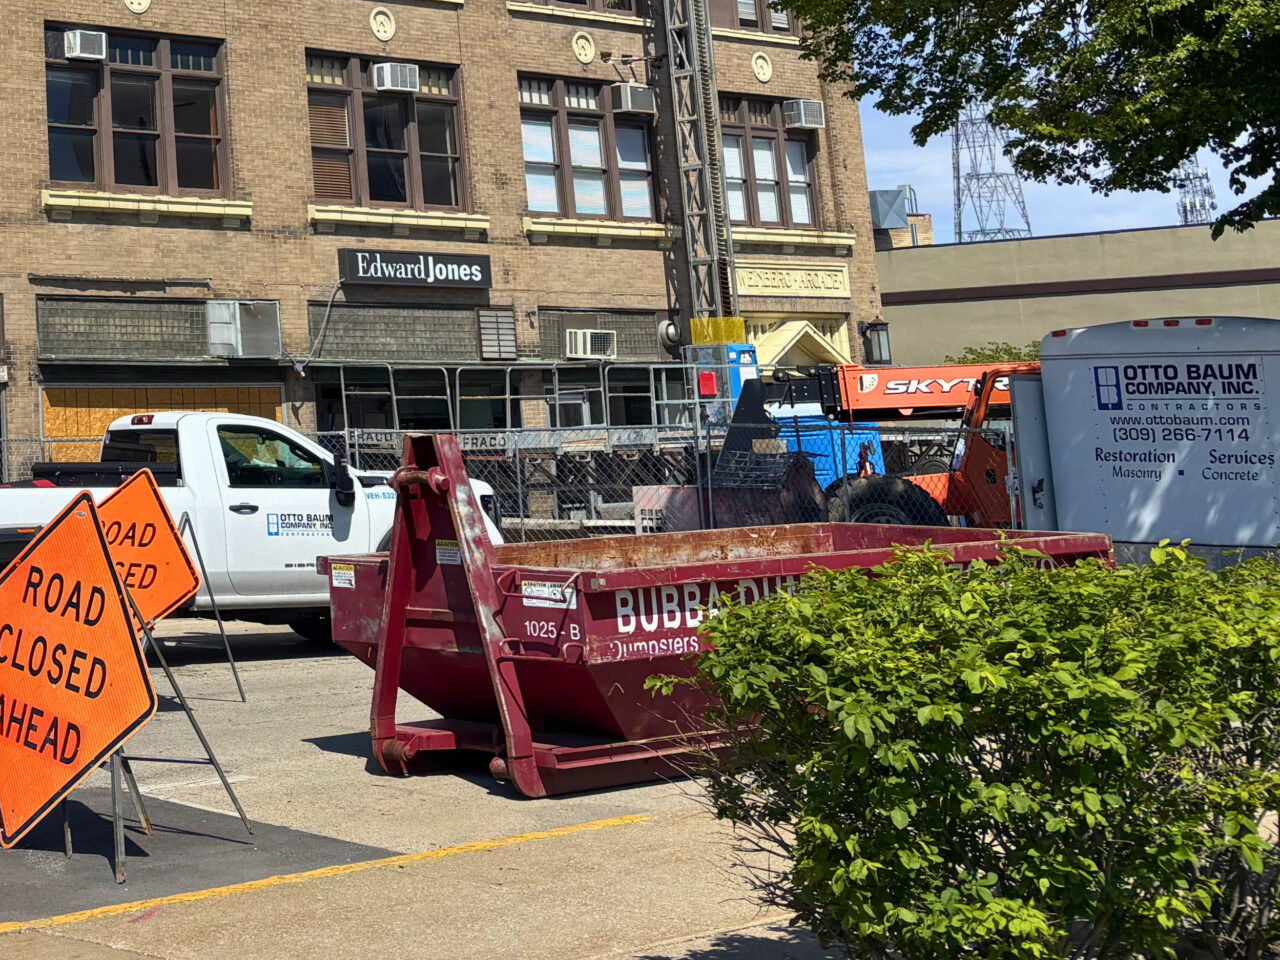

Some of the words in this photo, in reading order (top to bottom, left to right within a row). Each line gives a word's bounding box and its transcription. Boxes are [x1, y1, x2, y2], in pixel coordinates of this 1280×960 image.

[798, 271, 840, 290] ARCADE
[1123, 364, 1178, 381] OTTO
[1186, 363, 1258, 380] BAUM
[883, 376, 1010, 395] SKYTR
[1125, 381, 1216, 397] COMPANY,
[1221, 380, 1259, 395] INC.
[1126, 402, 1261, 411] CONTRACTORS
[1109, 414, 1250, 426] www.ottobaum.com
[463, 435, 506, 448] FRACO
[1113, 427, 1156, 443] (309)
[1161, 427, 1250, 442] 266-7114
[1095, 447, 1176, 464] Restoration
[1209, 448, 1275, 466] Services
[1112, 465, 1162, 482] Masonry
[1202, 467, 1259, 482] Concrete
[280, 513, 303, 522] OTTO
[306, 513, 334, 522] BAUM
[101, 520, 157, 548] OAD
[22, 565, 105, 627] ROAD
[614, 581, 721, 634] BUBBA
